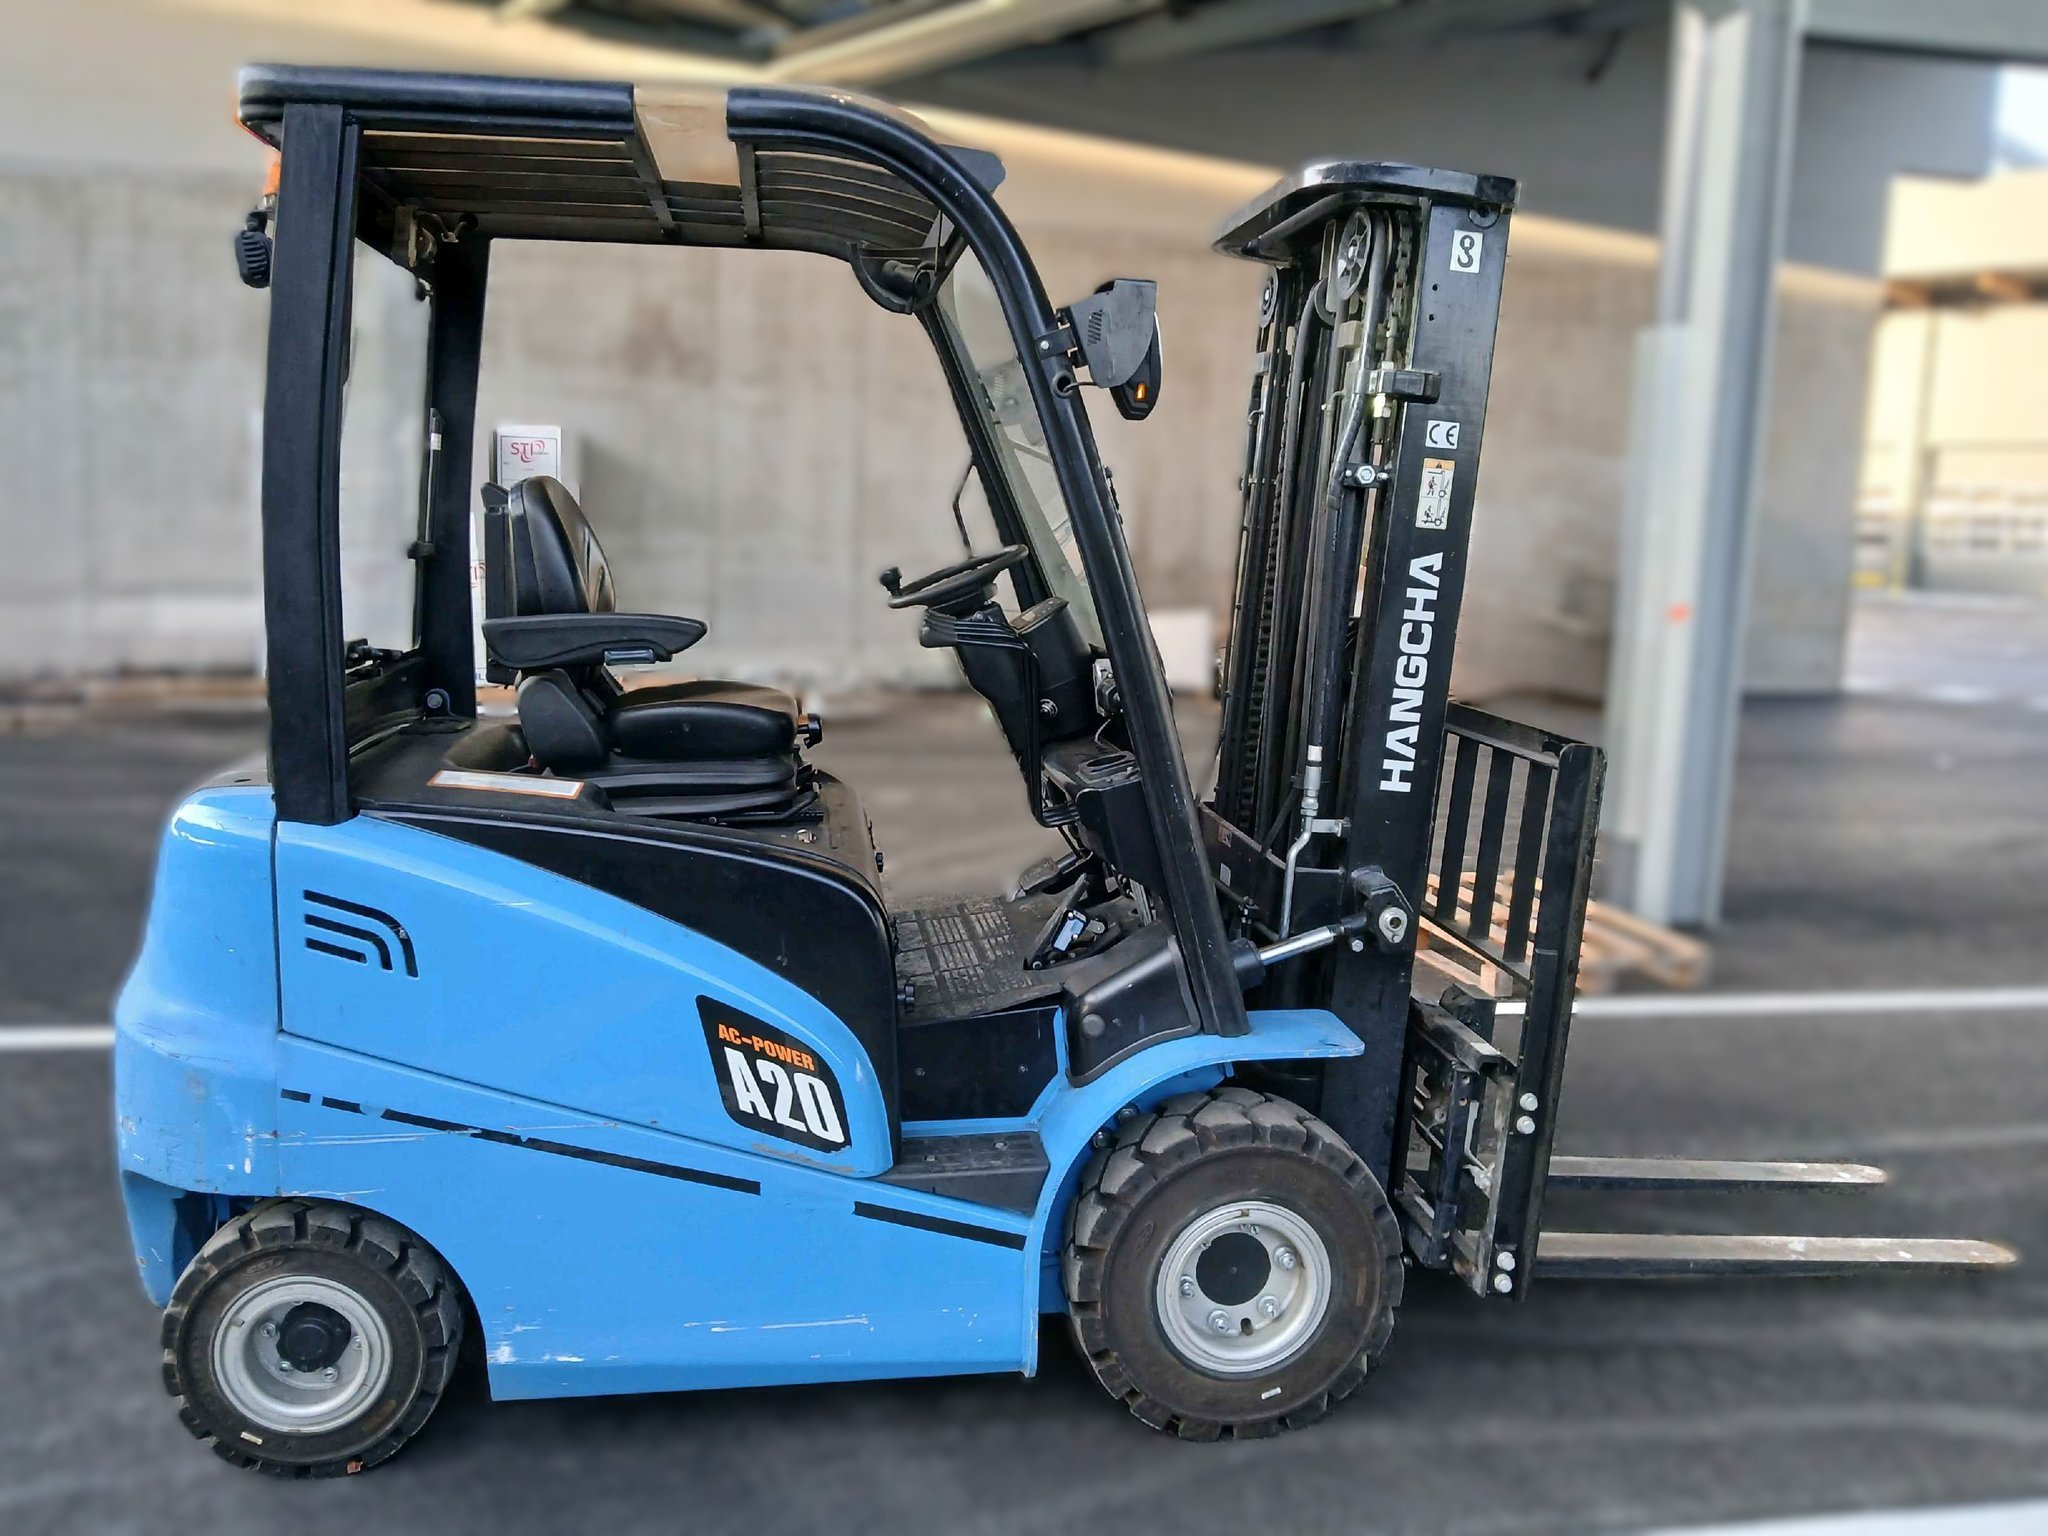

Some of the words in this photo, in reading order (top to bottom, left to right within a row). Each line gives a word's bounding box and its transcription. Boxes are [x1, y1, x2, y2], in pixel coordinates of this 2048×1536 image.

[511, 442, 534, 456] STI
[1428, 423, 1458, 447] CE
[1379, 551, 1444, 794] HANGCHA
[717, 1023, 815, 1072] AC-POWER
[723, 1046, 845, 1144] A20
